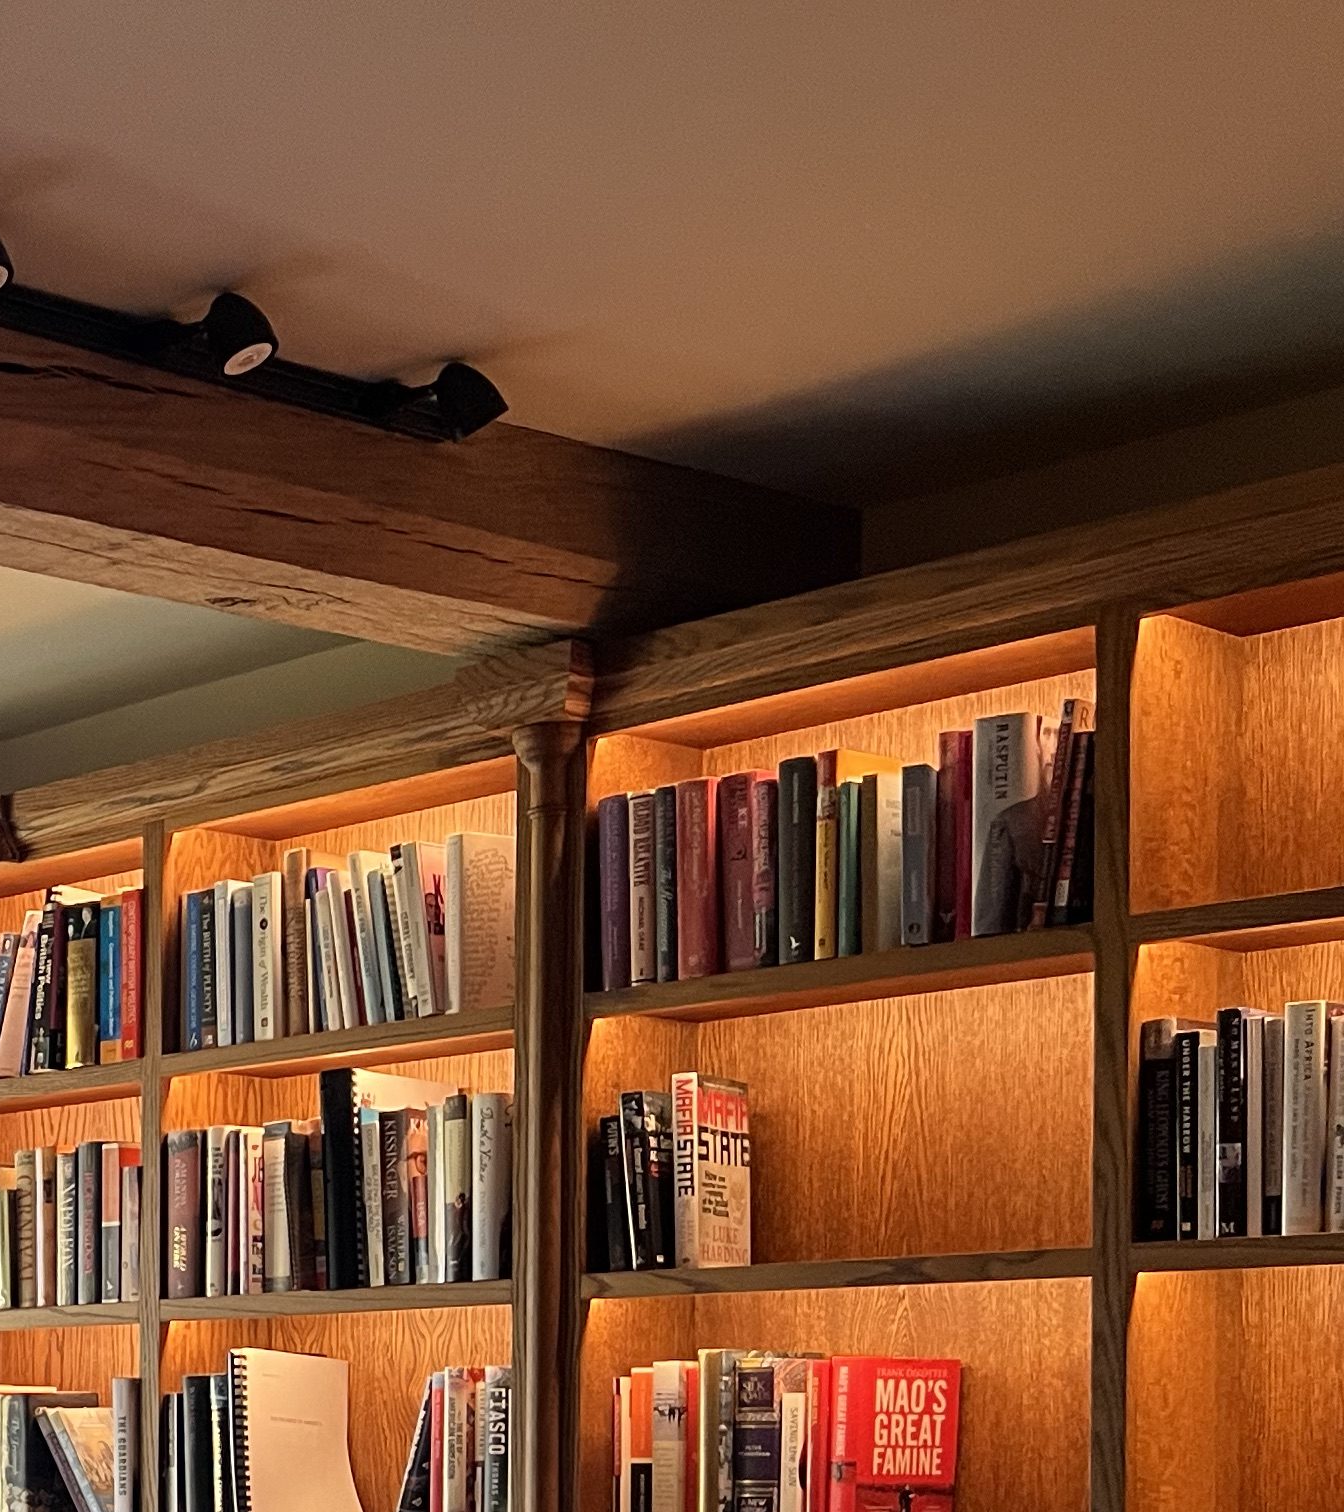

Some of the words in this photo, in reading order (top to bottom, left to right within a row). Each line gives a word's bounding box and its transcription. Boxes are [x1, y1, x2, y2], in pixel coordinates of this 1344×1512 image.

[994, 723, 1009, 801] RASPUTIN
[633, 800, 650, 835] BLOOD
[633, 838, 652, 887] RELATIVE
[203, 913, 211, 930] The
[259, 896, 267, 914] The
[38, 934, 49, 974] British
[202, 931, 212, 963] BIRTH
[128, 960, 136, 989] BRITISH
[260, 971, 268, 1011] Wealth
[35, 976, 45, 1020] Politics
[127, 991, 136, 1024] POLITICS
[203, 975, 212, 1013] PLENTY
[1304, 1008, 1316, 1036] INTO
[1182, 1040, 1191, 1077] UNDER
[1303, 1040, 1315, 1082] AFRICA
[676, 1078, 694, 1137] MAFIA
[697, 1087, 748, 1134] MAFIA
[1182, 1082, 1191, 1102] THE
[698, 1127, 751, 1167] STATE
[1182, 1106, 1191, 1154] HARROW
[382, 1119, 398, 1199] KISSINGER
[677, 1139, 695, 1197] STATE
[17, 1175, 34, 1280] CARNIVAL
[60, 1183, 75, 1269] NAPOLEON
[83, 1209, 95, 1274] KINGDOM
[173, 1226, 181, 1243] ON
[712, 1226, 738, 1244] LUKE
[173, 1245, 181, 1268] FIRE
[180, 1234, 188, 1271] WORLD
[386, 1225, 397, 1280] ISAACSON
[875, 1378, 948, 1414] MAO'S
[118, 1416, 127, 1433] THE
[488, 1387, 506, 1455] FIASCO
[790, 1407, 799, 1446] SAVING
[874, 1414, 946, 1447] GREAT
[118, 1438, 127, 1496] GUARDIANS
[788, 1467, 797, 1487] SUN
[872, 1447, 943, 1476] FAMINE
